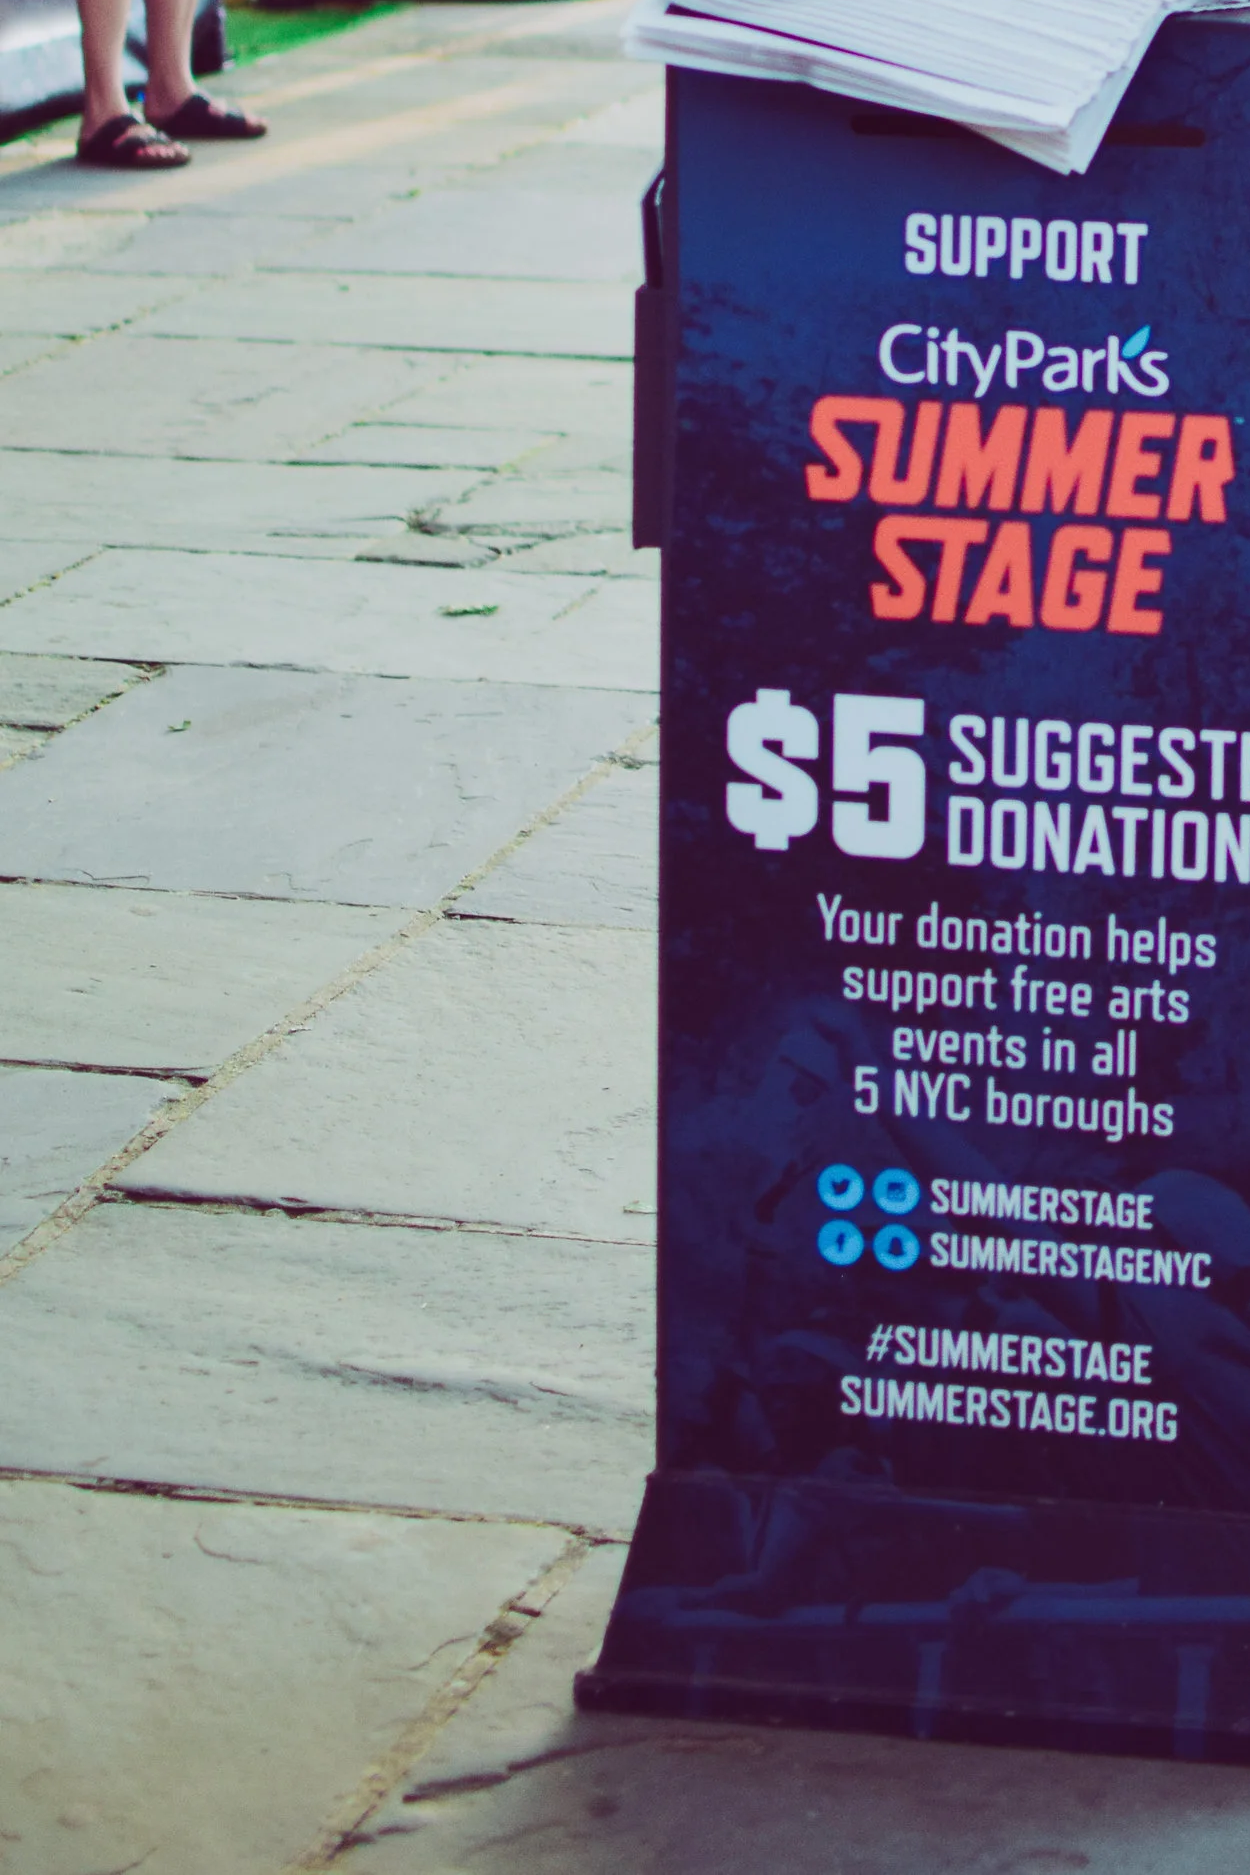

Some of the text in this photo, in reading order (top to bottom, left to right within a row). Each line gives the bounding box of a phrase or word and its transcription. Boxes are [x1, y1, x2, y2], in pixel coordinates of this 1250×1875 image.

[905, 212, 1149, 285] SUPPORT
[879, 324, 1170, 398] CityParks
[805, 395, 1235, 524] SUMMER
[869, 514, 1173, 635] STAGE
[726, 688, 926, 860] $5
[817, 892, 1217, 975] Your donation helps
[843, 964, 1190, 1023] support free arts
[893, 1025, 1137, 1077] events in all
[854, 1065, 1174, 1142] 5 NYC boroughs
[930, 1178, 1154, 1230] SUMMERSTAGE
[930, 1232, 1212, 1288] SUMMERSTAGENYC
[867, 1324, 1153, 1384] #SUMMERSTAGE
[841, 1375, 1178, 1441] SUMMERSTAGE.ORG
